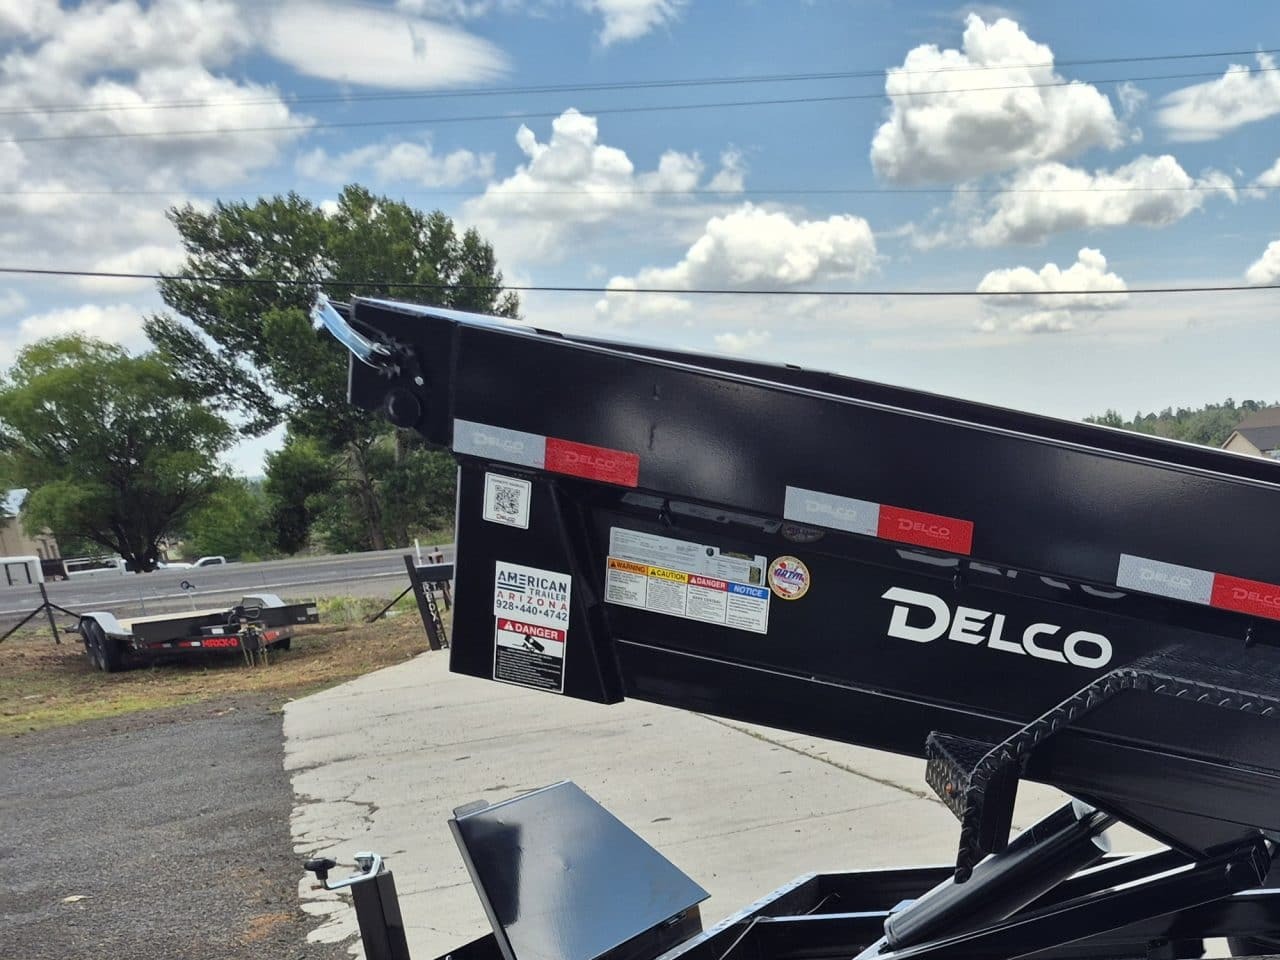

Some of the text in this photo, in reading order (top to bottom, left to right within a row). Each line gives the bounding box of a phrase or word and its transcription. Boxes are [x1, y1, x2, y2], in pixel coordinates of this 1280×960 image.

[565, 452, 617, 470] DELCO
[898, 519, 950, 536] DELCO
[616, 561, 646, 574] WARNING
[656, 570, 686, 581] CAUTION
[498, 570, 568, 593] AMERICAN
[695, 578, 726, 589] DANGER
[530, 588, 567, 601] TRAILER
[733, 585, 763, 597] NOTICE
[497, 590, 568, 611] ARIZONA
[515, 623, 558, 640] DANGER
[881, 586, 1113, 669] DELCO
